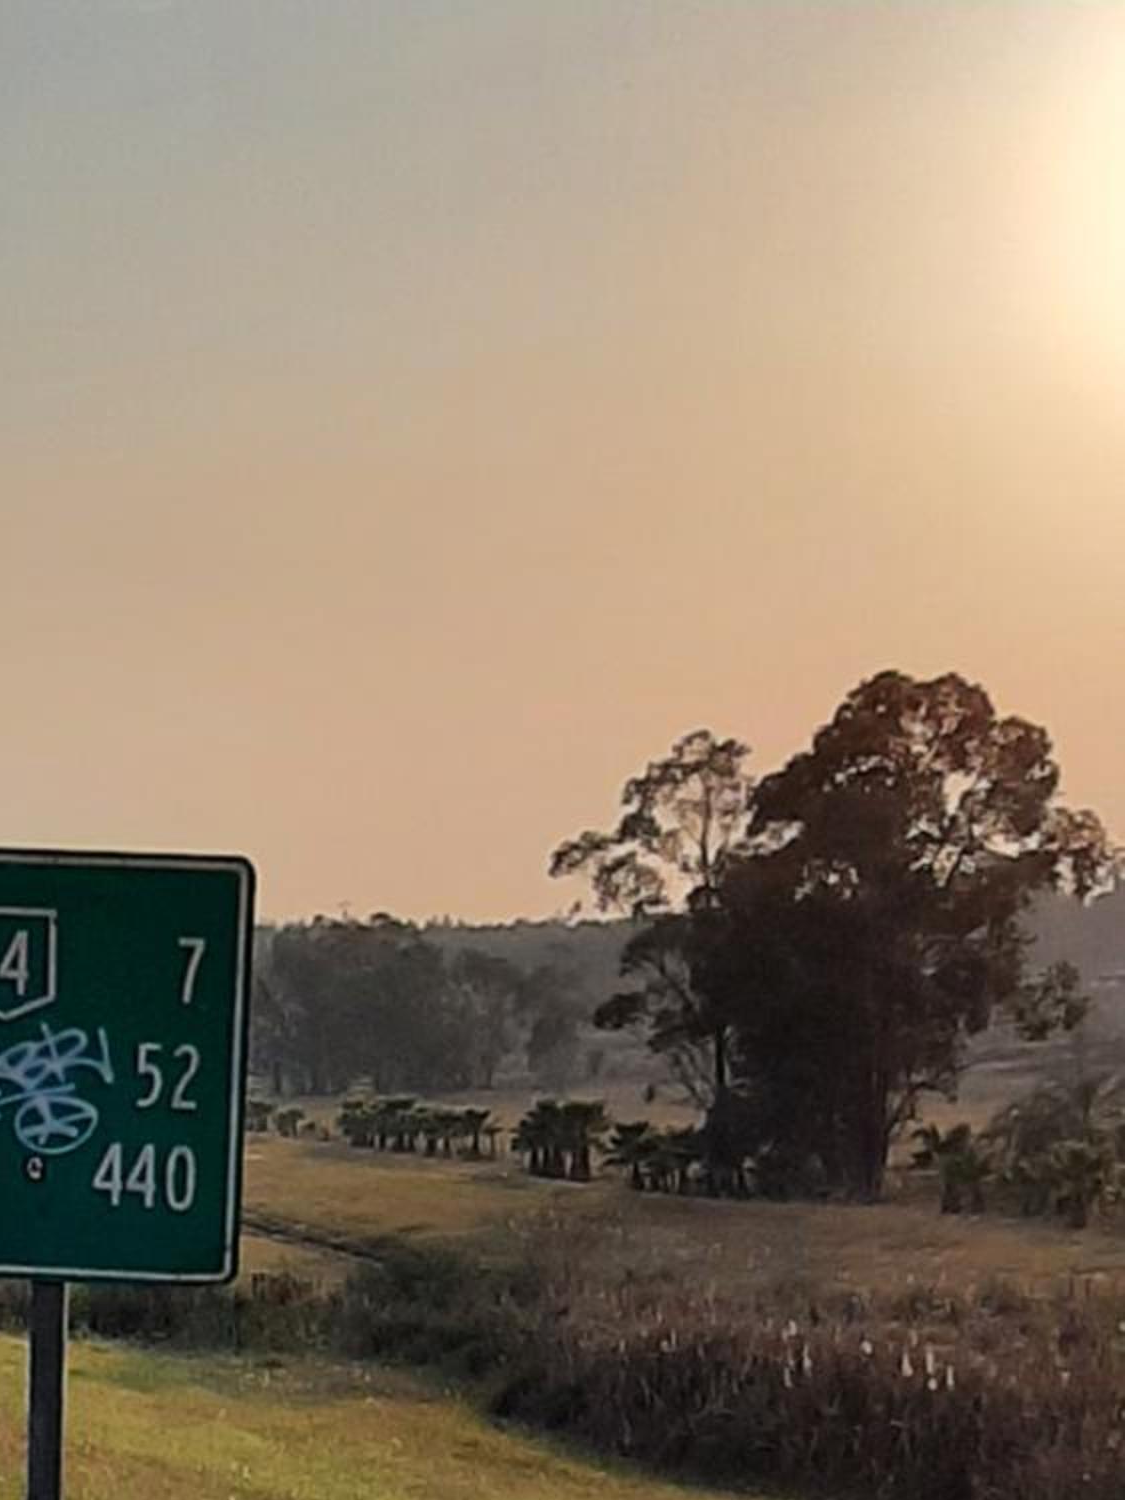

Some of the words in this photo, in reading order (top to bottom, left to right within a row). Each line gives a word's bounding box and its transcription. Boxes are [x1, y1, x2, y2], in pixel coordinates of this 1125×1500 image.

[177, 938, 205, 1004] 7
[136, 1042, 200, 1110] 52
[92, 1142, 196, 1212] 440
